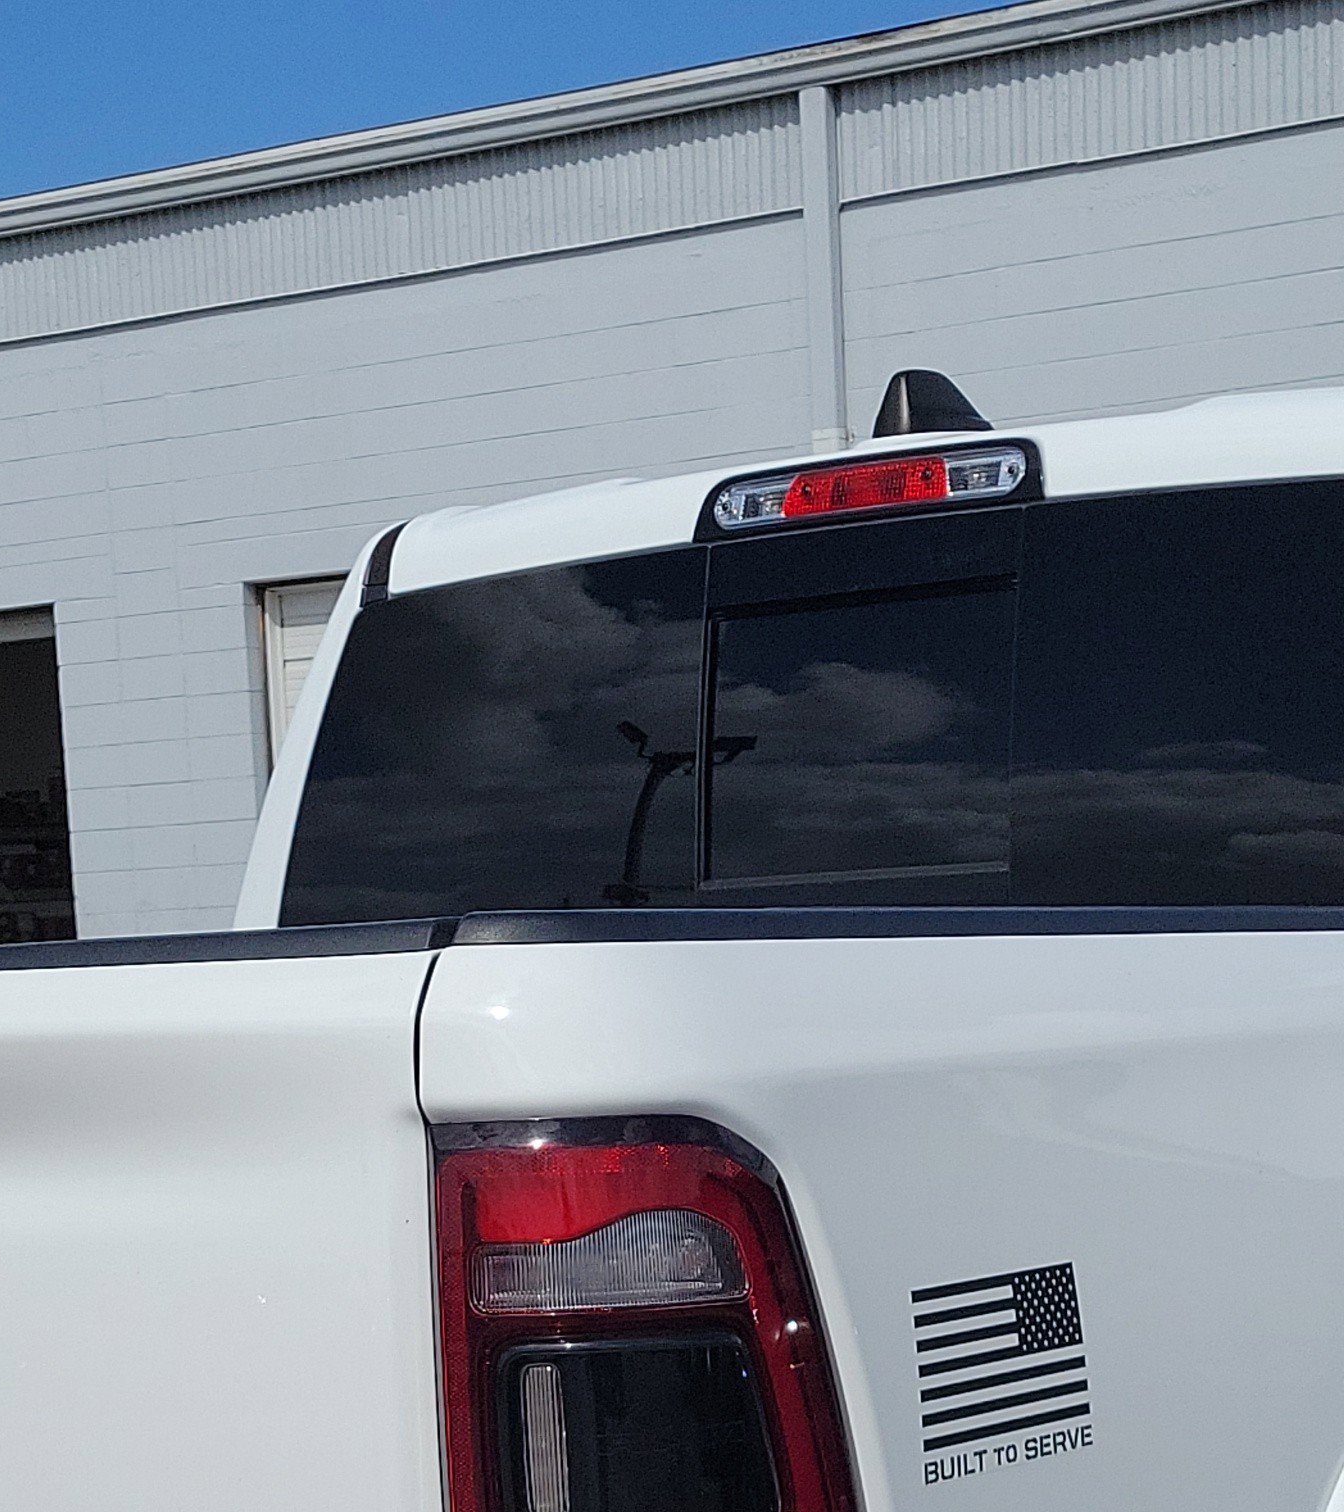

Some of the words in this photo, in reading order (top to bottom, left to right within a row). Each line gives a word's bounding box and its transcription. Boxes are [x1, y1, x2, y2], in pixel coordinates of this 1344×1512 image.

[924, 1449, 987, 1485] BUILT
[993, 1444, 1018, 1466] TO
[1024, 1425, 1093, 1460] SERVE
